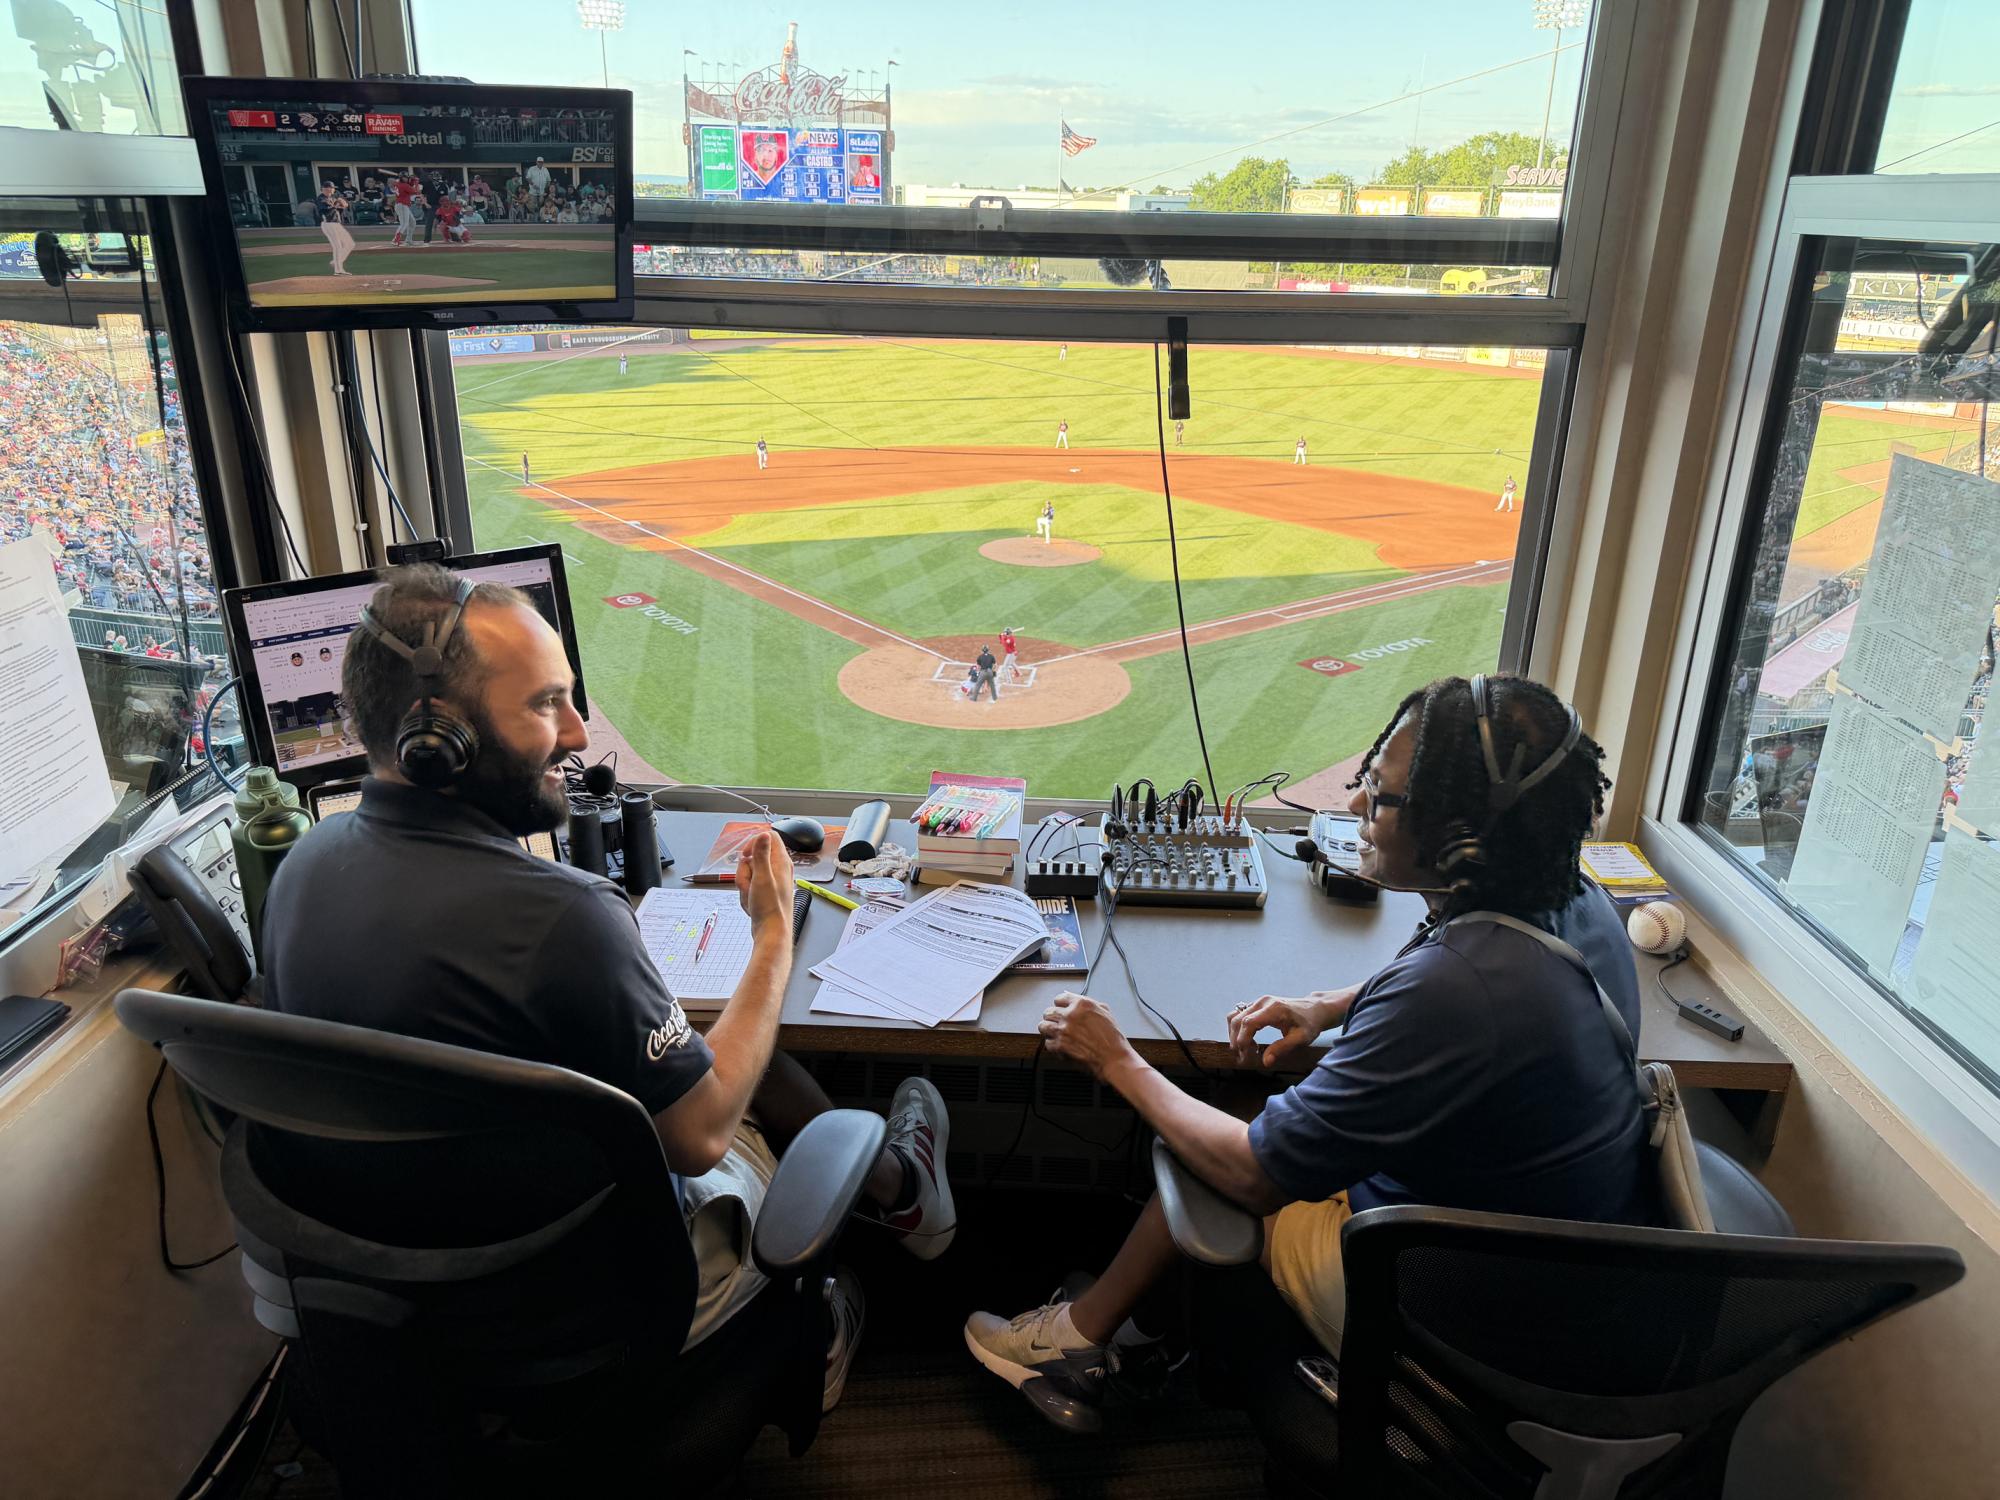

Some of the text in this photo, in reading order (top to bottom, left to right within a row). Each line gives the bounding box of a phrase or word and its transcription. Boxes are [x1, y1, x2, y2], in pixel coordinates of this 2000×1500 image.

[261, 114, 268, 124] 1
[281, 114, 291, 125] 2
[368, 118, 401, 126] RAV4th
[385, 131, 443, 147] Capital
[809, 133, 837, 143] NEWS
[572, 147, 598, 162] BSI
[806, 156, 833, 167] CASTRO
[1503, 197, 1557, 208] KeyBank
[588, 335, 627, 344] STROUDSBURG
[463, 341, 485, 352] First
[637, 604, 699, 635] TOYOTA
[1346, 637, 1435, 661] TOYOTA
[1034, 899, 1070, 914] UIDE
